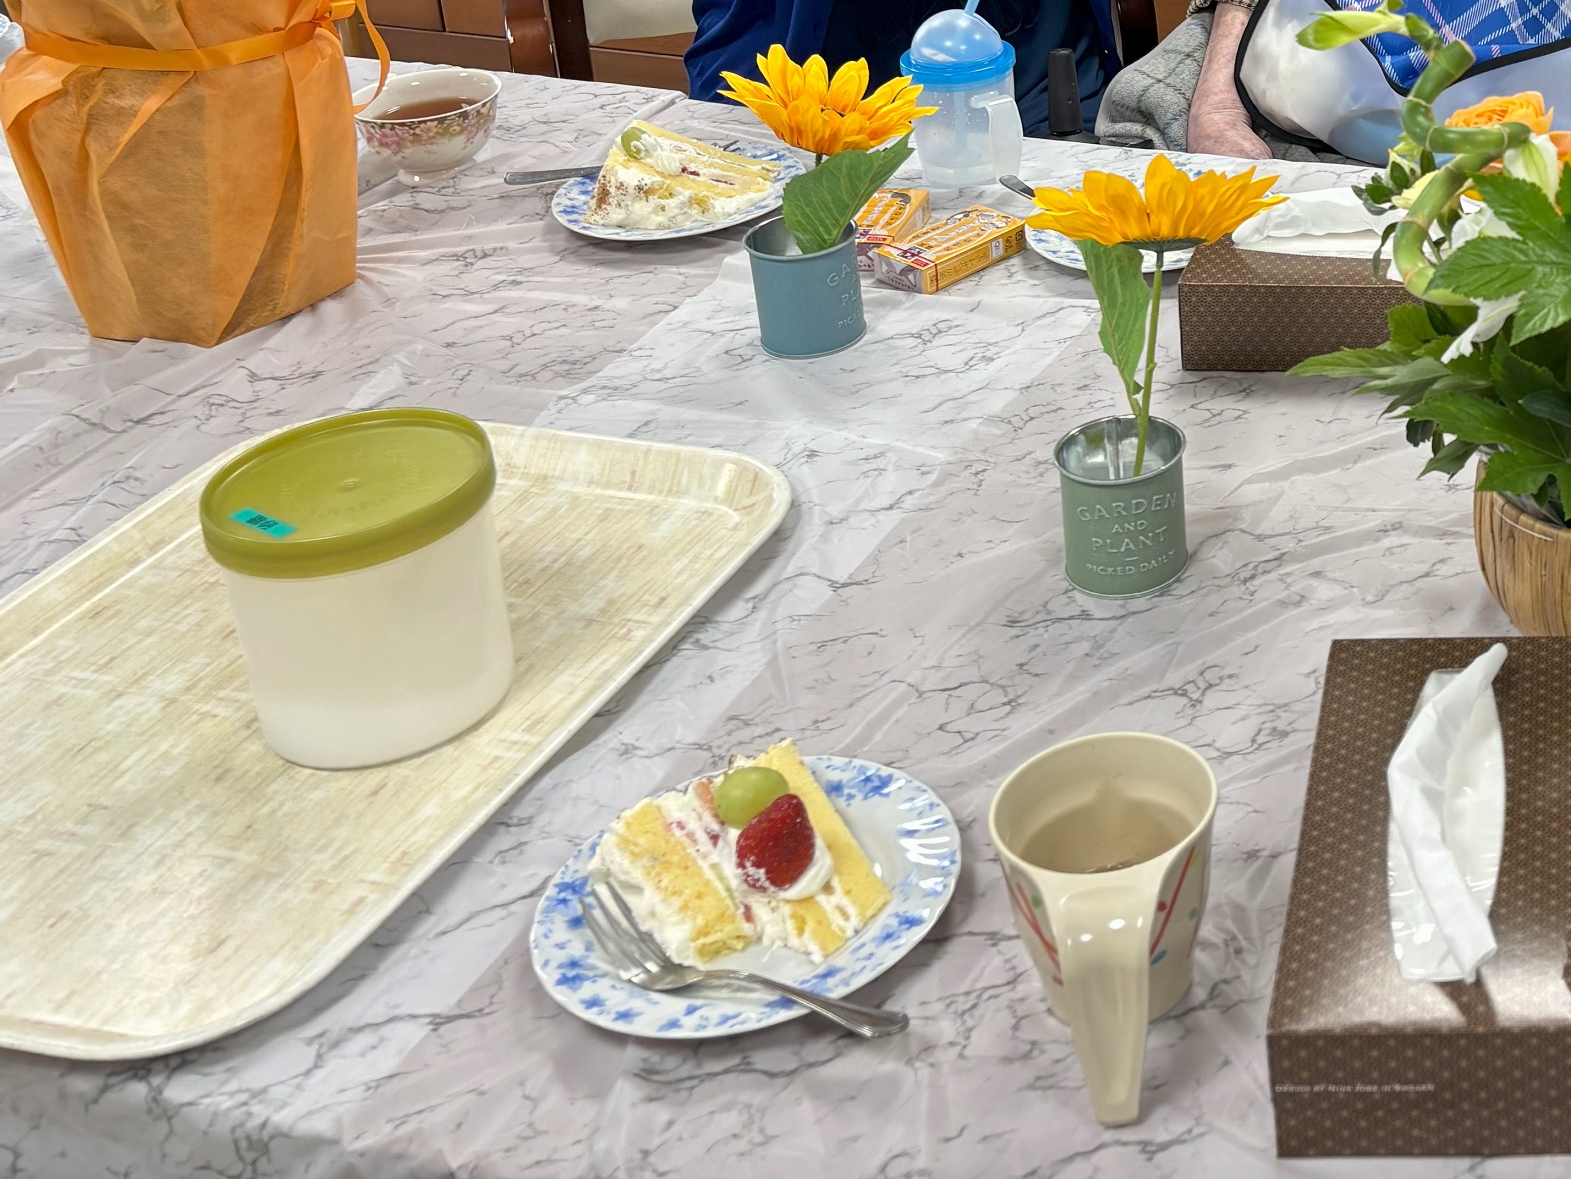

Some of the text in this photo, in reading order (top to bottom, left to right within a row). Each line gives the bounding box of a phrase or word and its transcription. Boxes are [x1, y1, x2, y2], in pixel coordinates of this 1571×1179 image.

[1076, 492, 1177, 521] GARDEN
[1112, 520, 1148, 534] AND
[1092, 526, 1168, 553] PLANT
[1086, 563, 1136, 575] PICKED
